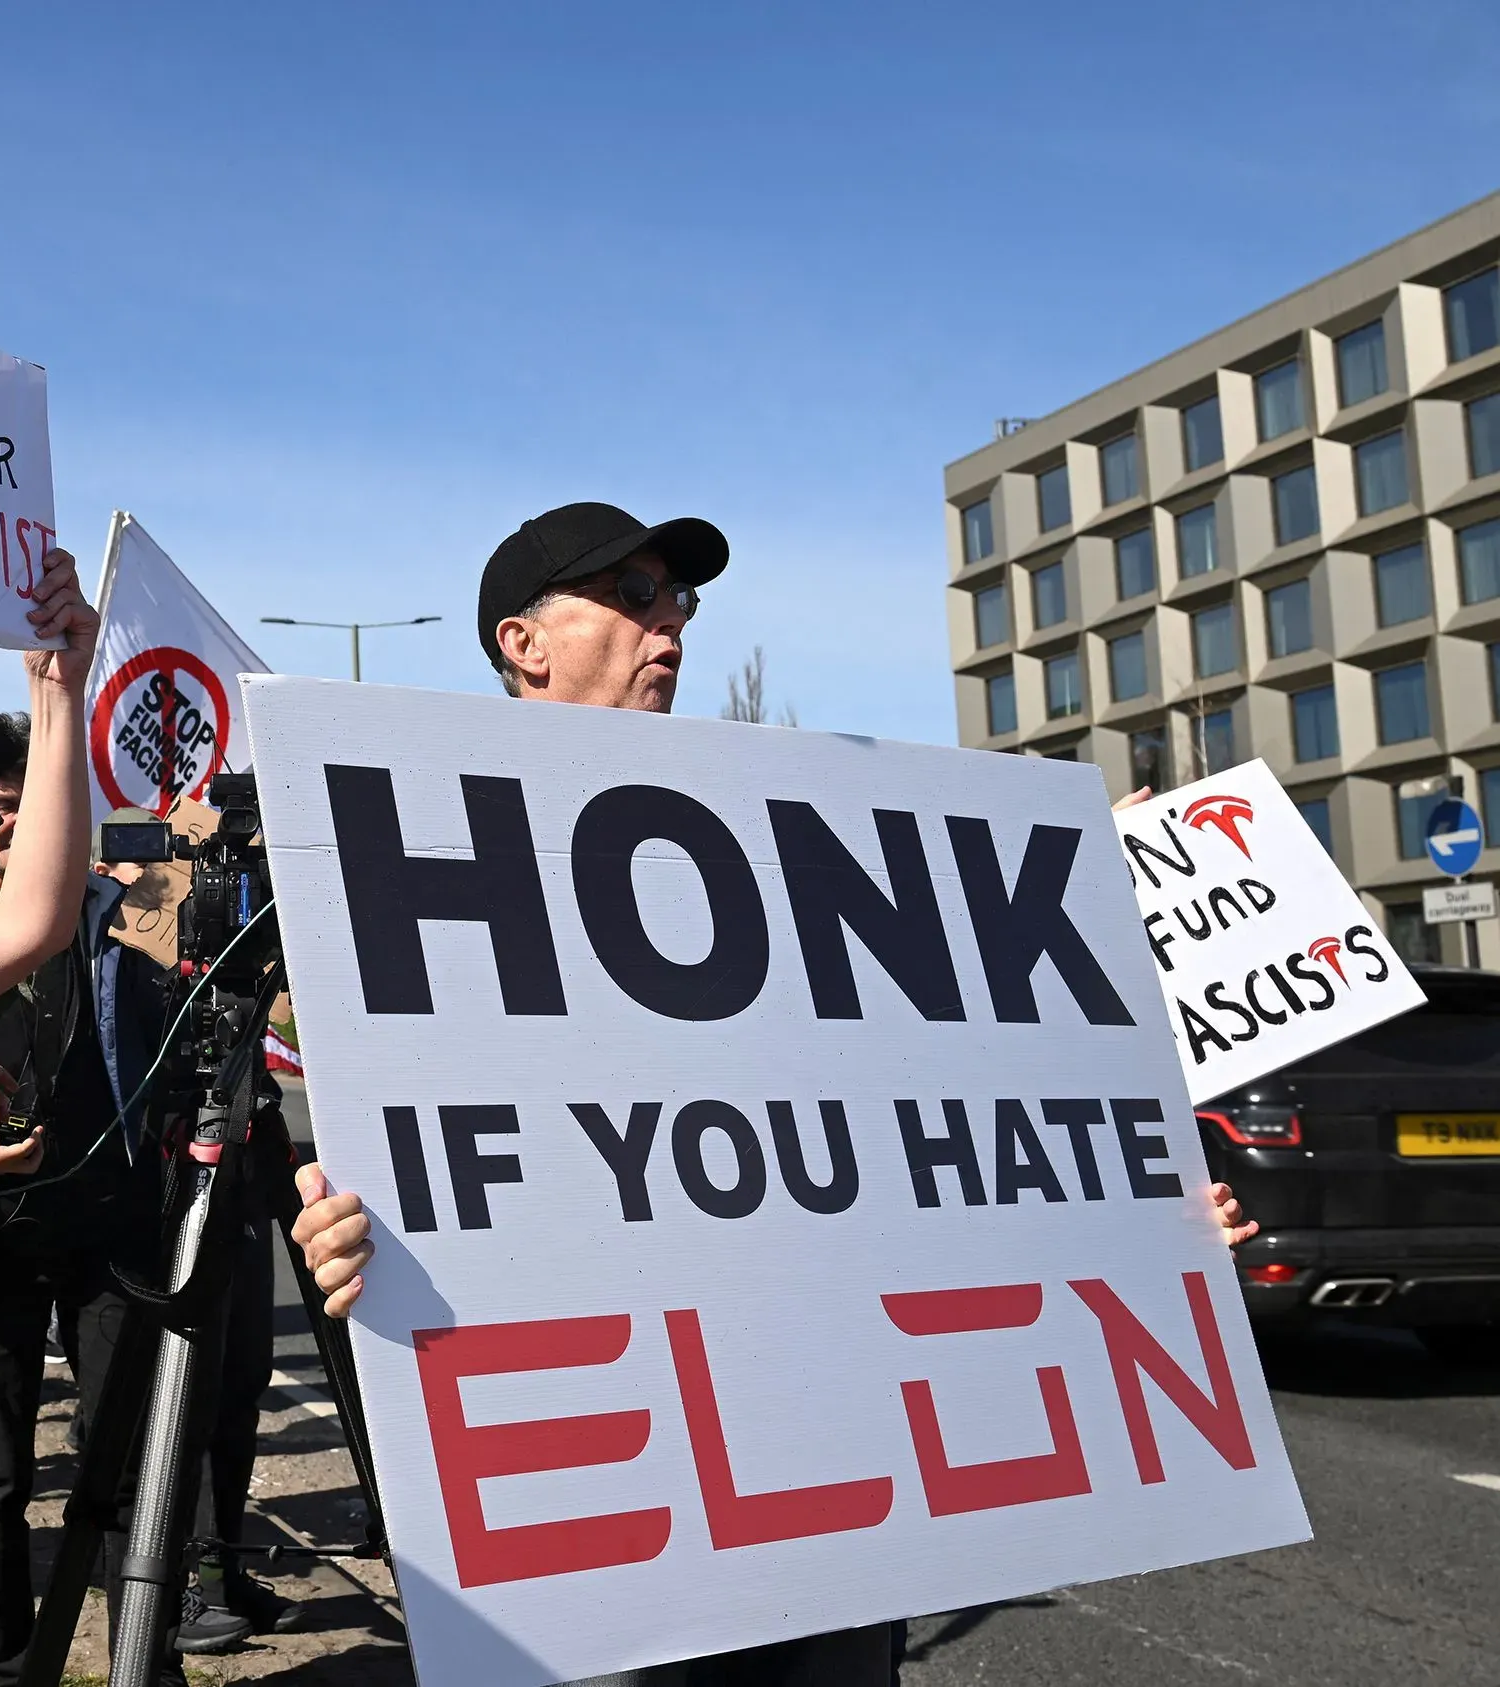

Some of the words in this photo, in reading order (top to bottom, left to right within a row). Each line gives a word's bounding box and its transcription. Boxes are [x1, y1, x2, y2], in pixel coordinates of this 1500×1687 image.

[128, 703, 198, 782] FUNDING
[142, 673, 214, 753] STOP
[116, 724, 186, 798] FACISM
[324, 764, 1137, 1027] HONK
[1144, 878, 1277, 972] FUND
[1445, 890, 1470, 903] Dual
[1172, 925, 1389, 1065] ASCISTS
[383, 1104, 523, 1232] IF
[567, 1099, 859, 1222] YOU
[893, 1097, 1184, 1208] HATE
[411, 1271, 1257, 1589] ELON
